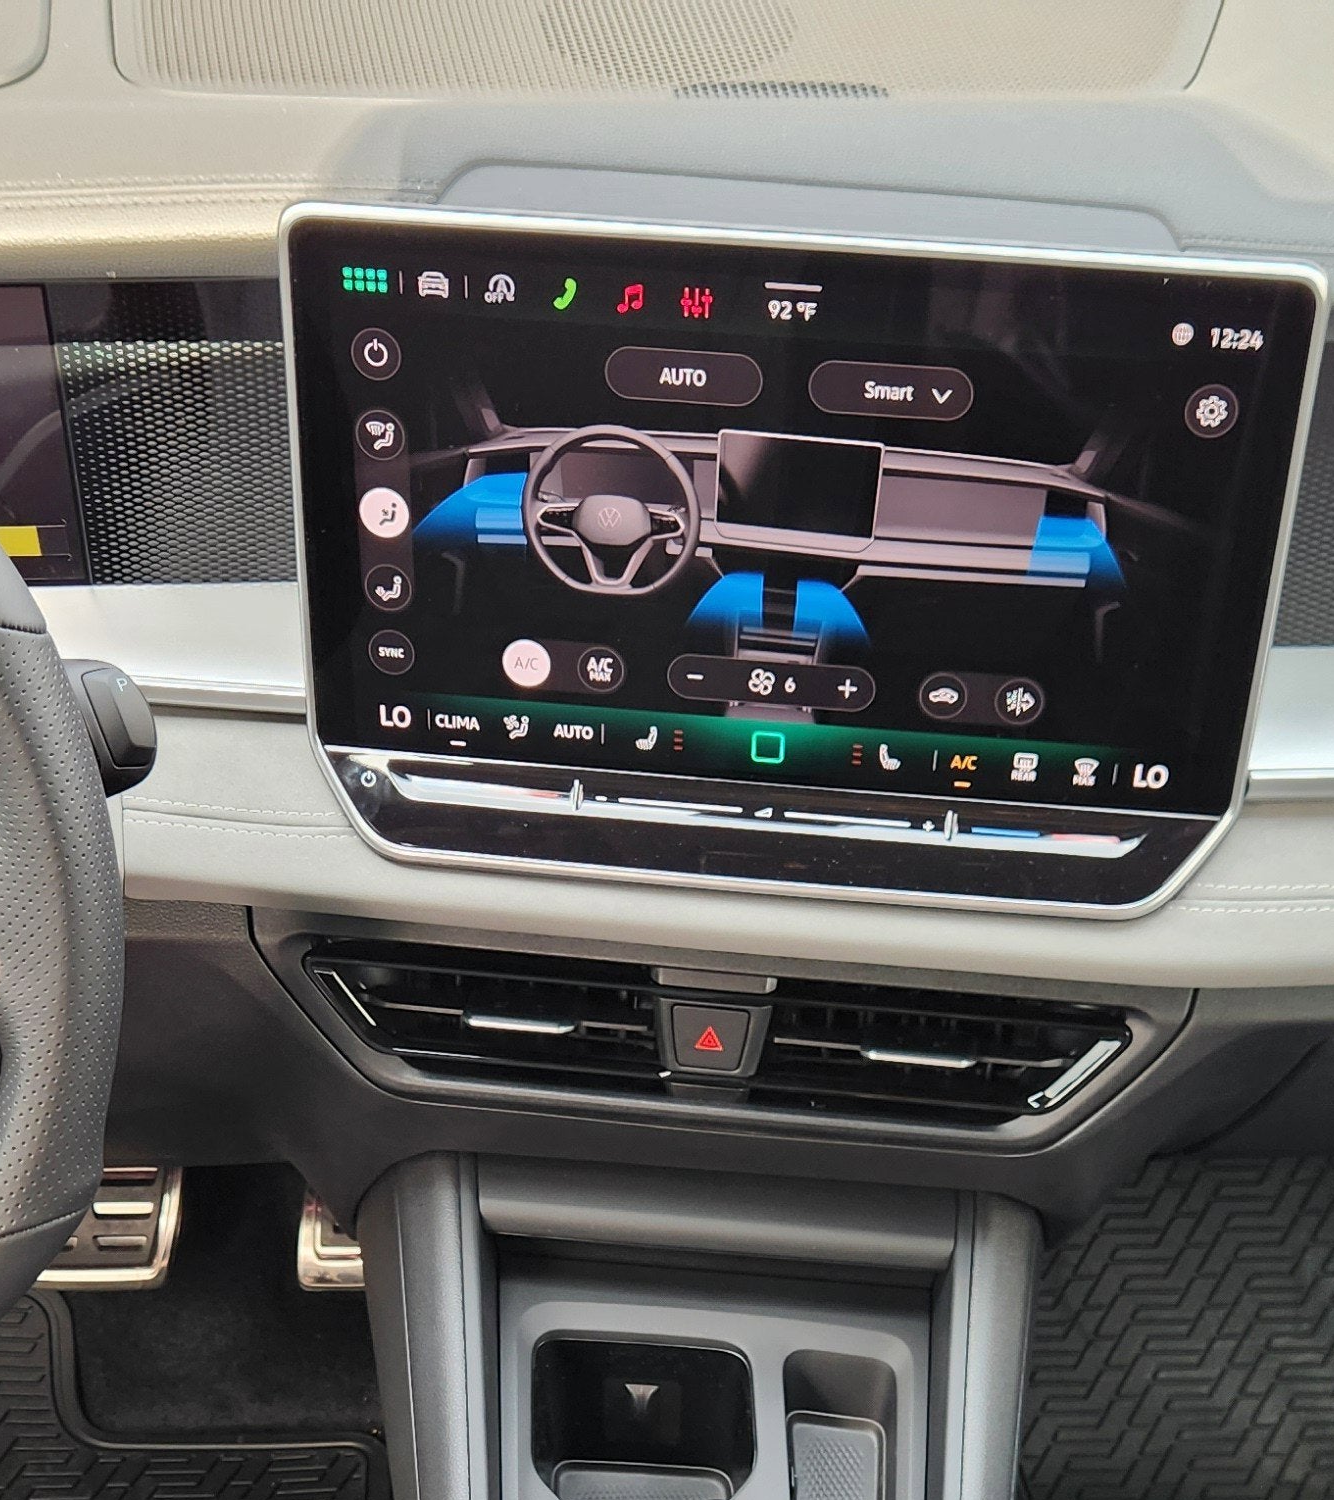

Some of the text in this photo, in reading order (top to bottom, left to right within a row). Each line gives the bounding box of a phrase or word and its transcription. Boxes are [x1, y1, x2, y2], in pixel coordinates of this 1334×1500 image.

[484, 291, 504, 303] OFF
[768, 300, 818, 322] 92 °F
[1209, 327, 1264, 351] 12:24
[658, 366, 707, 387] AUTO
[863, 381, 915, 403] Smart
[378, 645, 405, 659] SYNC
[514, 656, 540, 671] A/C
[586, 655, 614, 674] A/C
[589, 671, 612, 682] MAX
[783, 675, 797, 694] 6
[378, 703, 413, 729] LO
[435, 712, 481, 732] CLIMA
[553, 722, 594, 741] AUTO
[950, 753, 979, 771] A/C
[1009, 768, 1038, 783] REAR
[1131, 762, 1170, 790] LO
